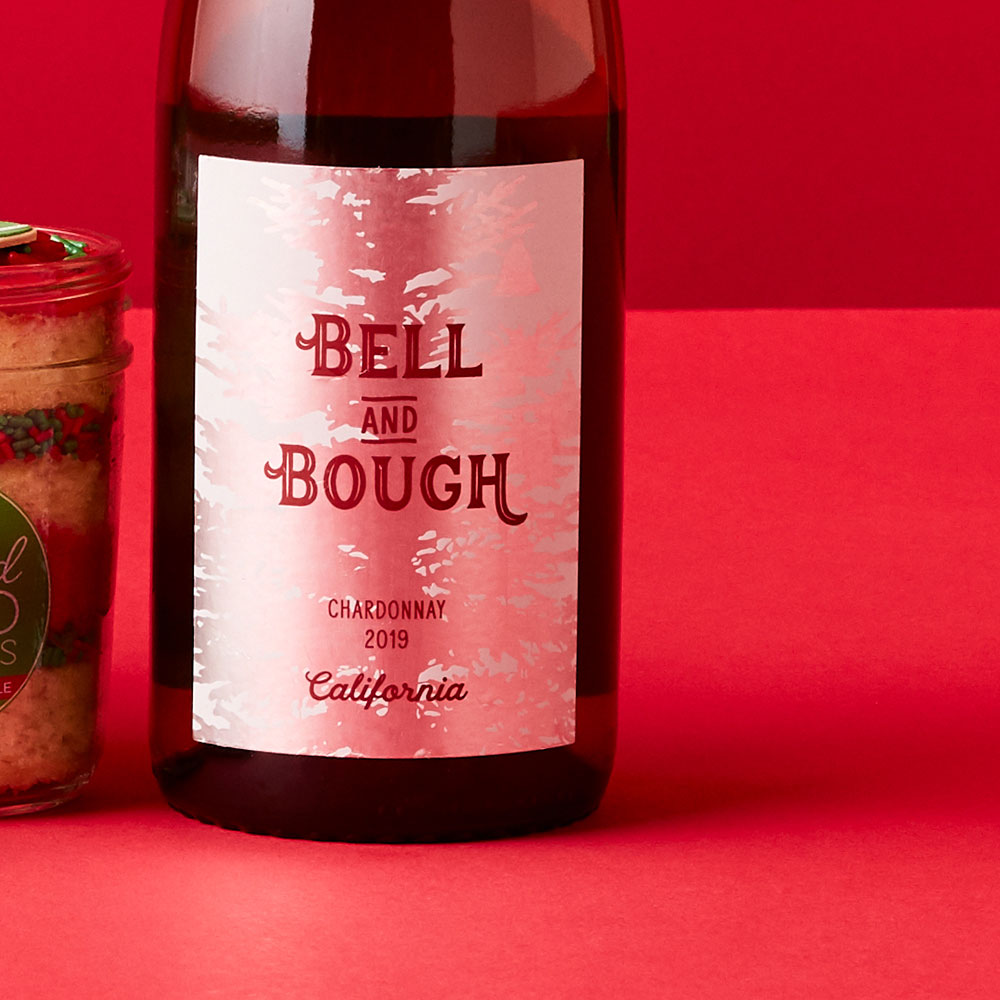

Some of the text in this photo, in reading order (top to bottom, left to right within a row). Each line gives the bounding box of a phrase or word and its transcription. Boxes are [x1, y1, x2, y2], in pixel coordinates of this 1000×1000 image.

[295, 313, 483, 379] BELL
[361, 405, 418, 435] AND
[263, 443, 529, 526] BOUGH
[328, 598, 446, 620] CHARDONNAY
[365, 629, 409, 649] 2019
[305, 670, 469, 710] California
